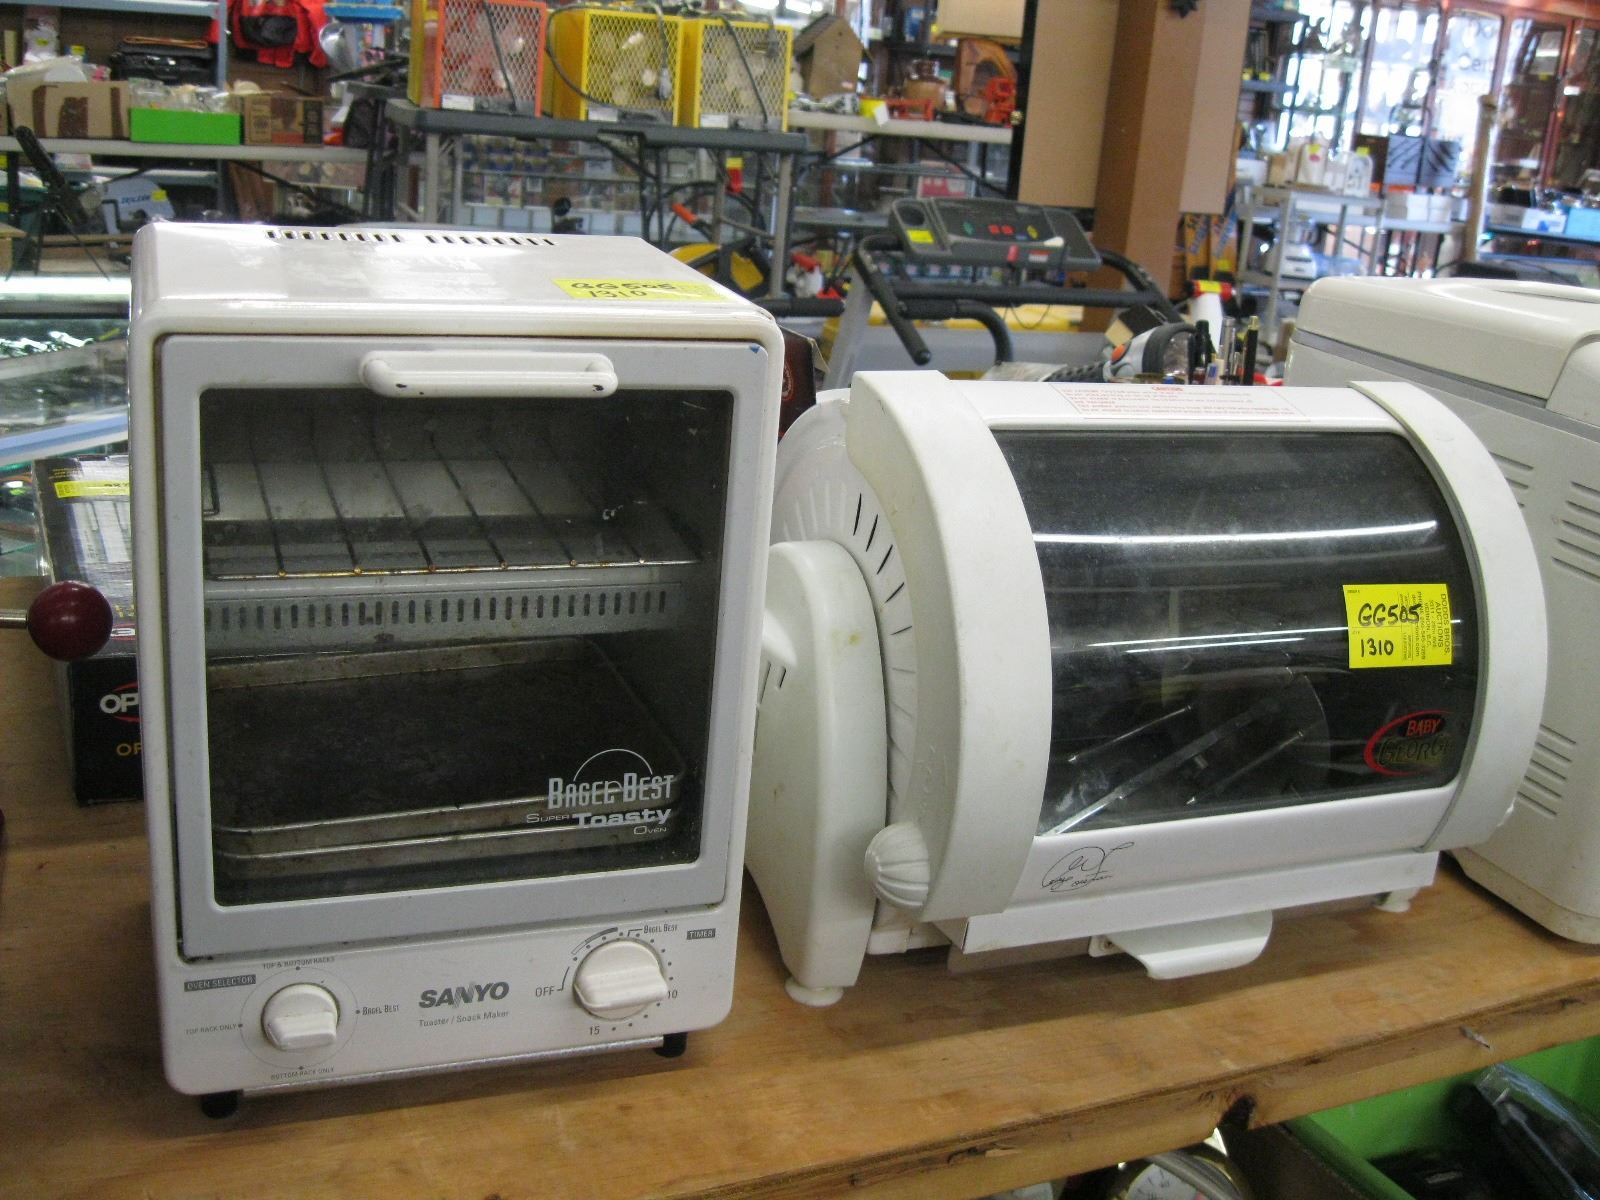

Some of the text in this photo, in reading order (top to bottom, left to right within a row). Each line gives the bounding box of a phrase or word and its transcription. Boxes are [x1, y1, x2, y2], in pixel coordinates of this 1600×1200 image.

[571, 282, 678, 290] GG505
[588, 290, 648, 299] 1310
[1358, 603, 1422, 627] GG505
[1435, 601, 1444, 648] AUCTIONS
[1361, 638, 1394, 658] 1310
[1406, 719, 1440, 736] BABY
[623, 773, 674, 802] BEST
[572, 808, 672, 828] Toasty
[689, 929, 714, 939] TIMER
[187, 976, 254, 990] OVEN SELECTOR
[418, 981, 510, 1009] SANYO
[535, 986, 555, 997] OFF
[667, 989, 678, 999] 10
[419, 1018, 449, 1028] Toaster
[457, 1013, 481, 1023] Snack
[483, 1010, 509, 1020] Maker
[219, 1023, 237, 1031] ONLY
[590, 1026, 600, 1036] 15
